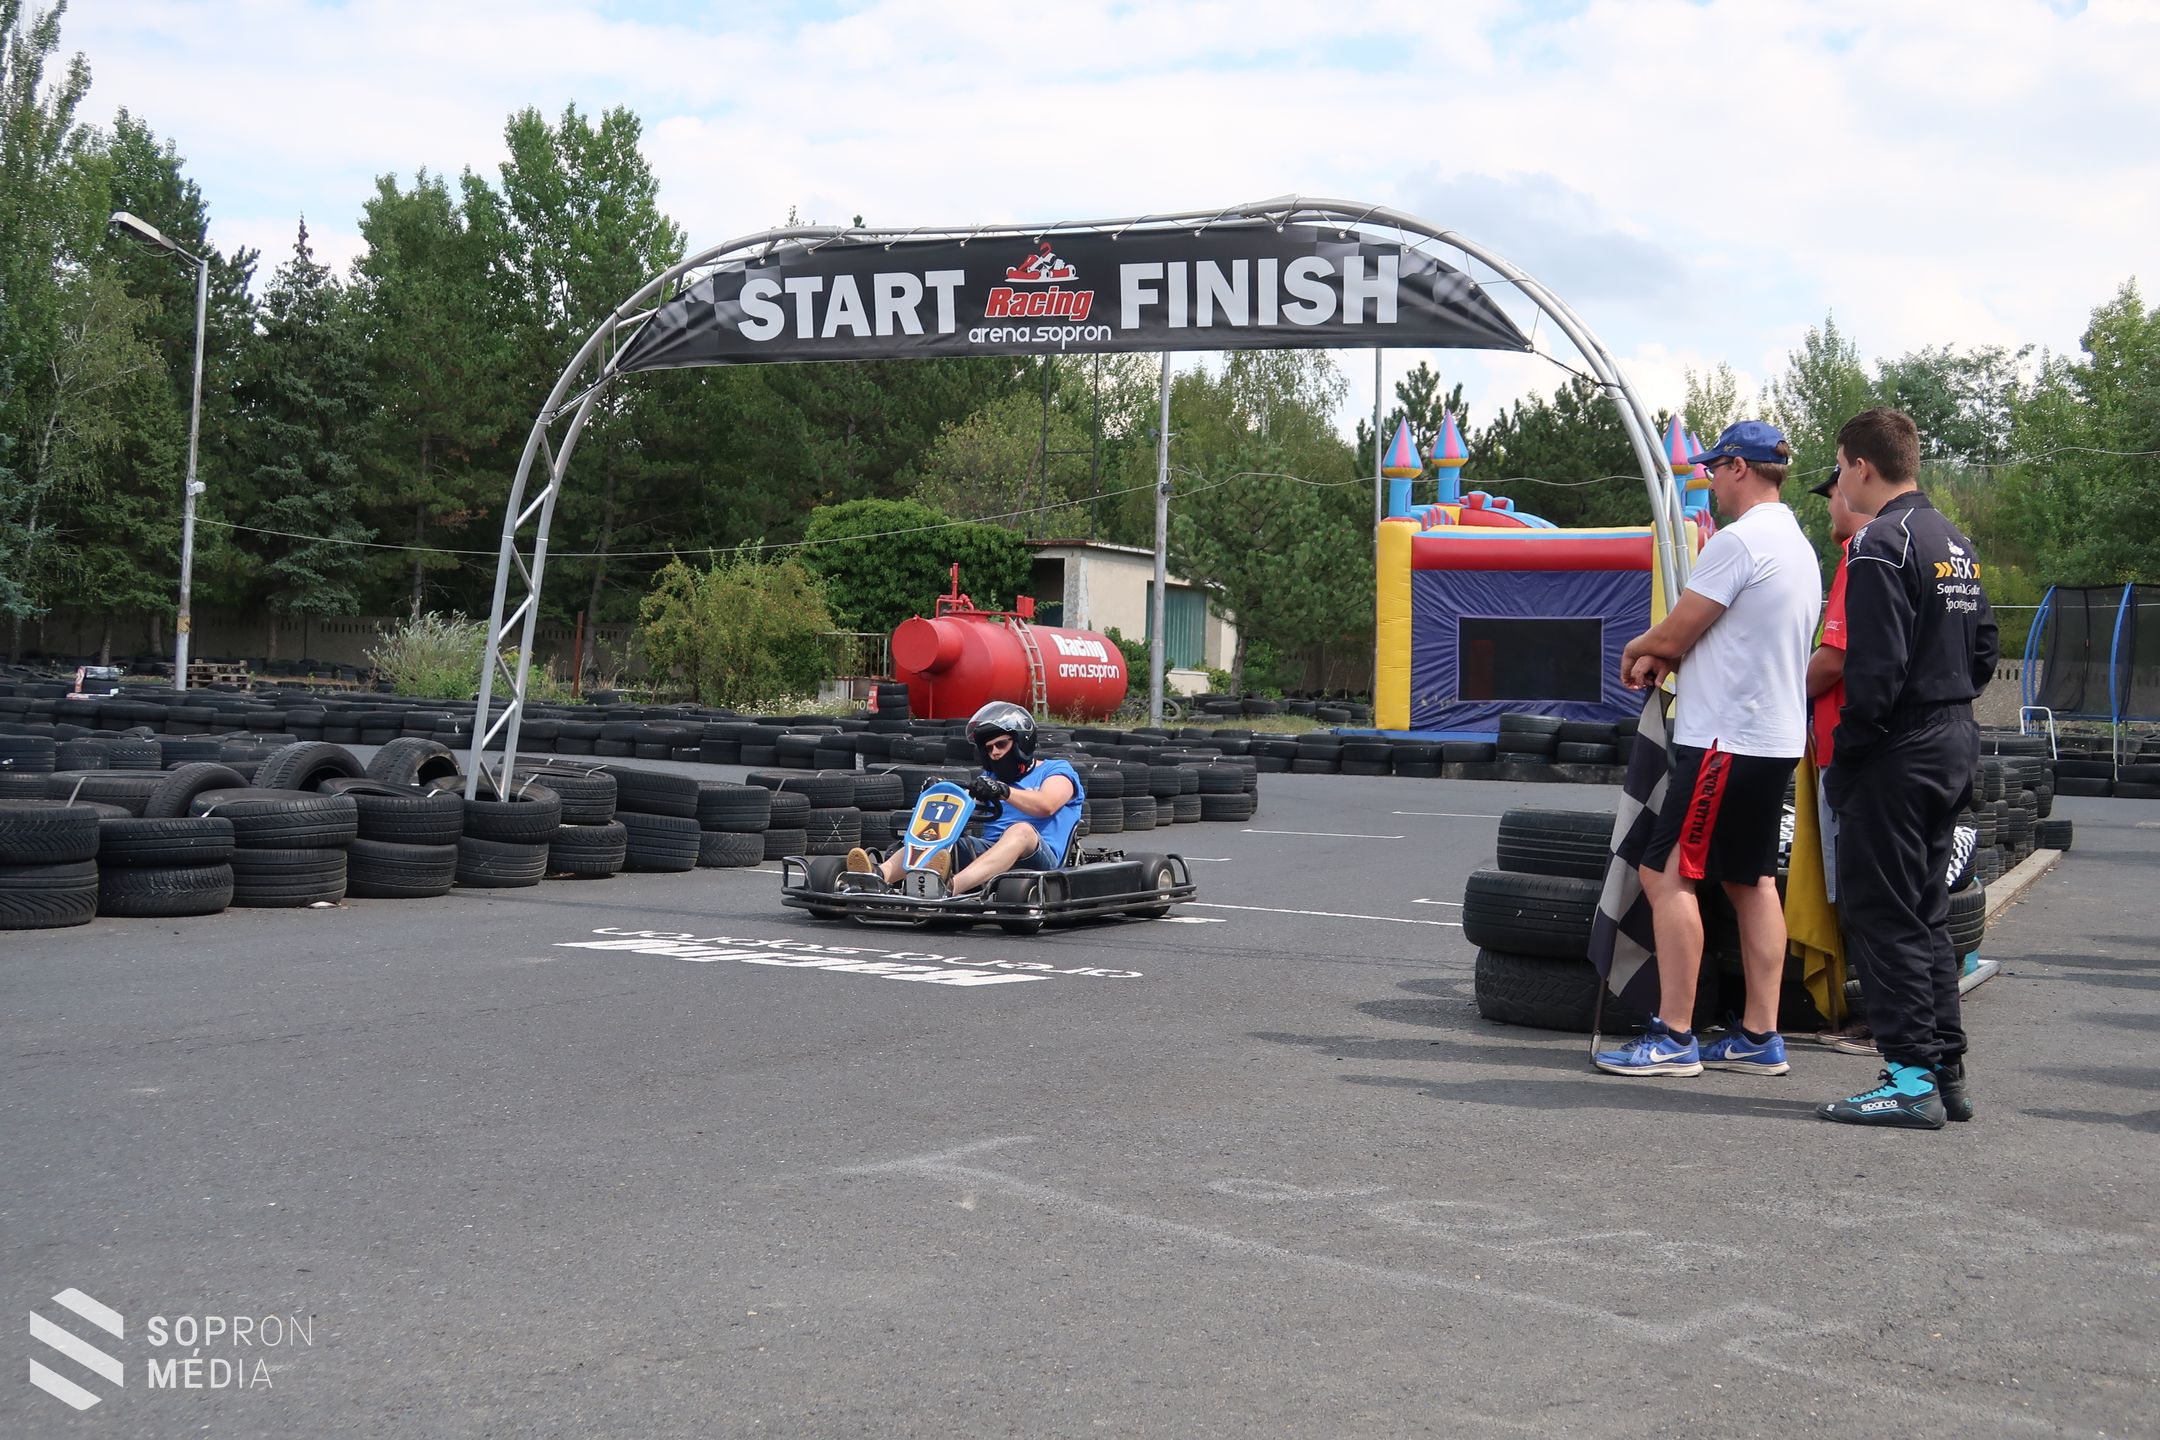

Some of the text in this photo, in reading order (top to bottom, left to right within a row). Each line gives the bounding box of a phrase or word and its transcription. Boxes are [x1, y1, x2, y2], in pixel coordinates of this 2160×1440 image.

[738, 254, 1399, 342] START FINISH
[984, 286, 1095, 321] Racing
[1050, 633, 1108, 663] Racing
[935, 805, 945, 820] 1
